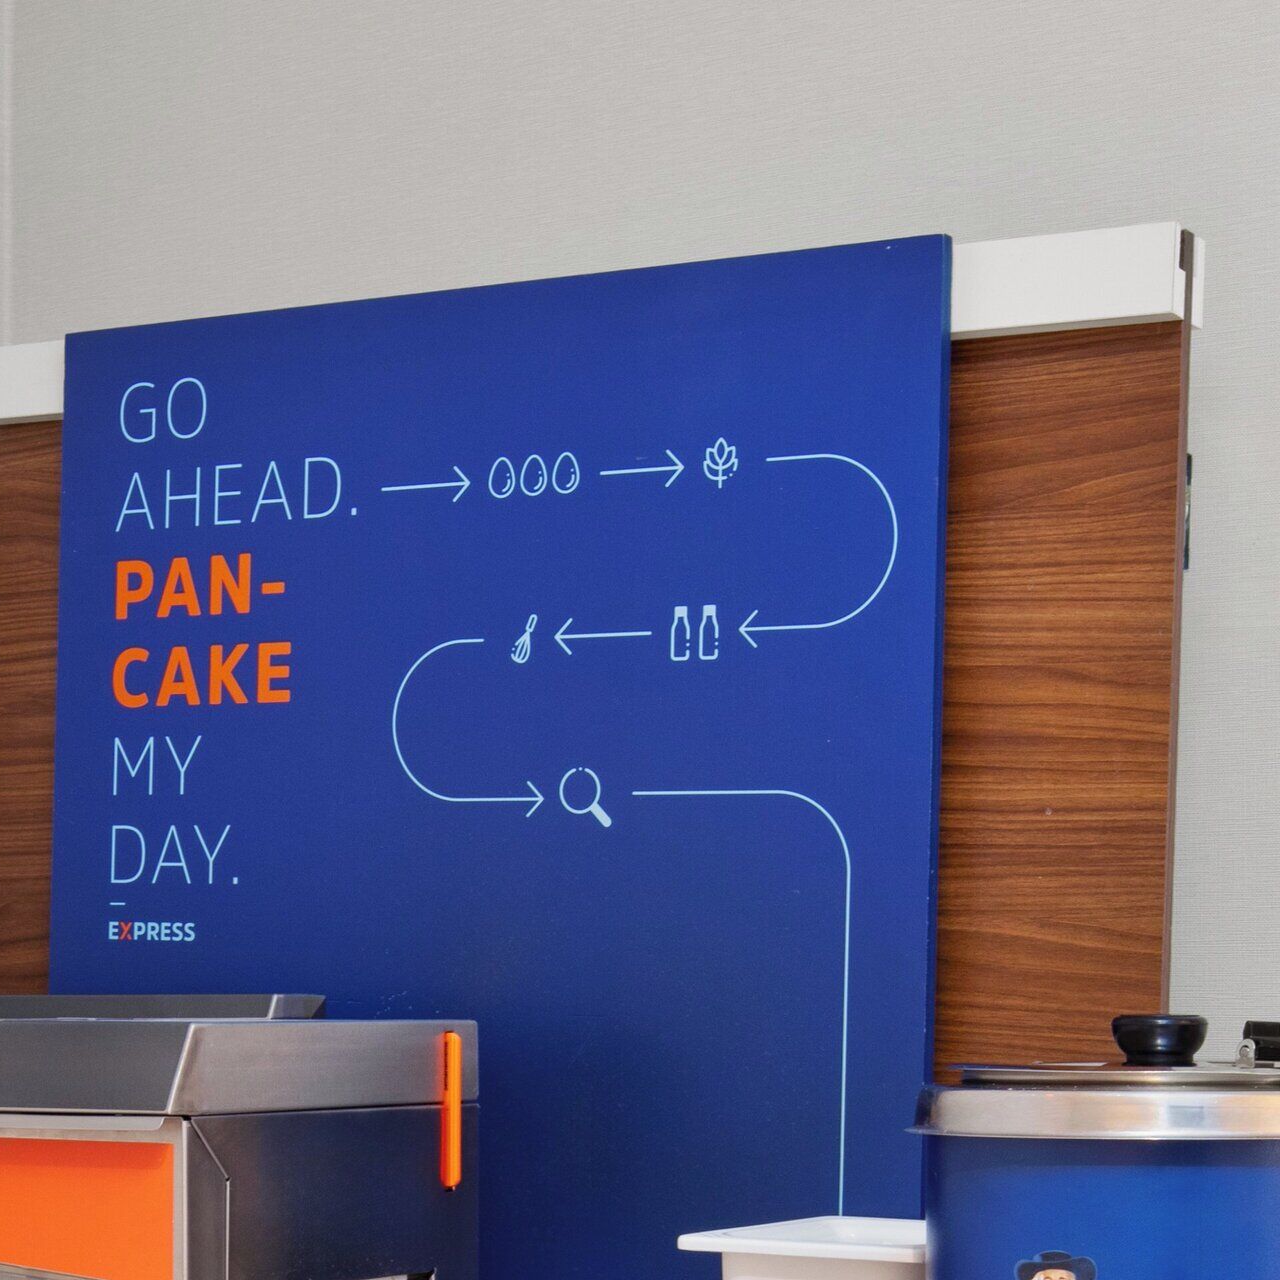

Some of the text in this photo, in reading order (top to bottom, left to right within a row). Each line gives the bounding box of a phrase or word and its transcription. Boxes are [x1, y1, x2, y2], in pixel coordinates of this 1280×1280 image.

[119, 377, 208, 444] GO
[115, 456, 359, 533] AHEAD.
[114, 552, 287, 620] PAN-
[111, 641, 293, 709] CAKE
[112, 735, 203, 797] MY
[109, 824, 240, 886] DAY.
[108, 921, 196, 942] EXPRESS
